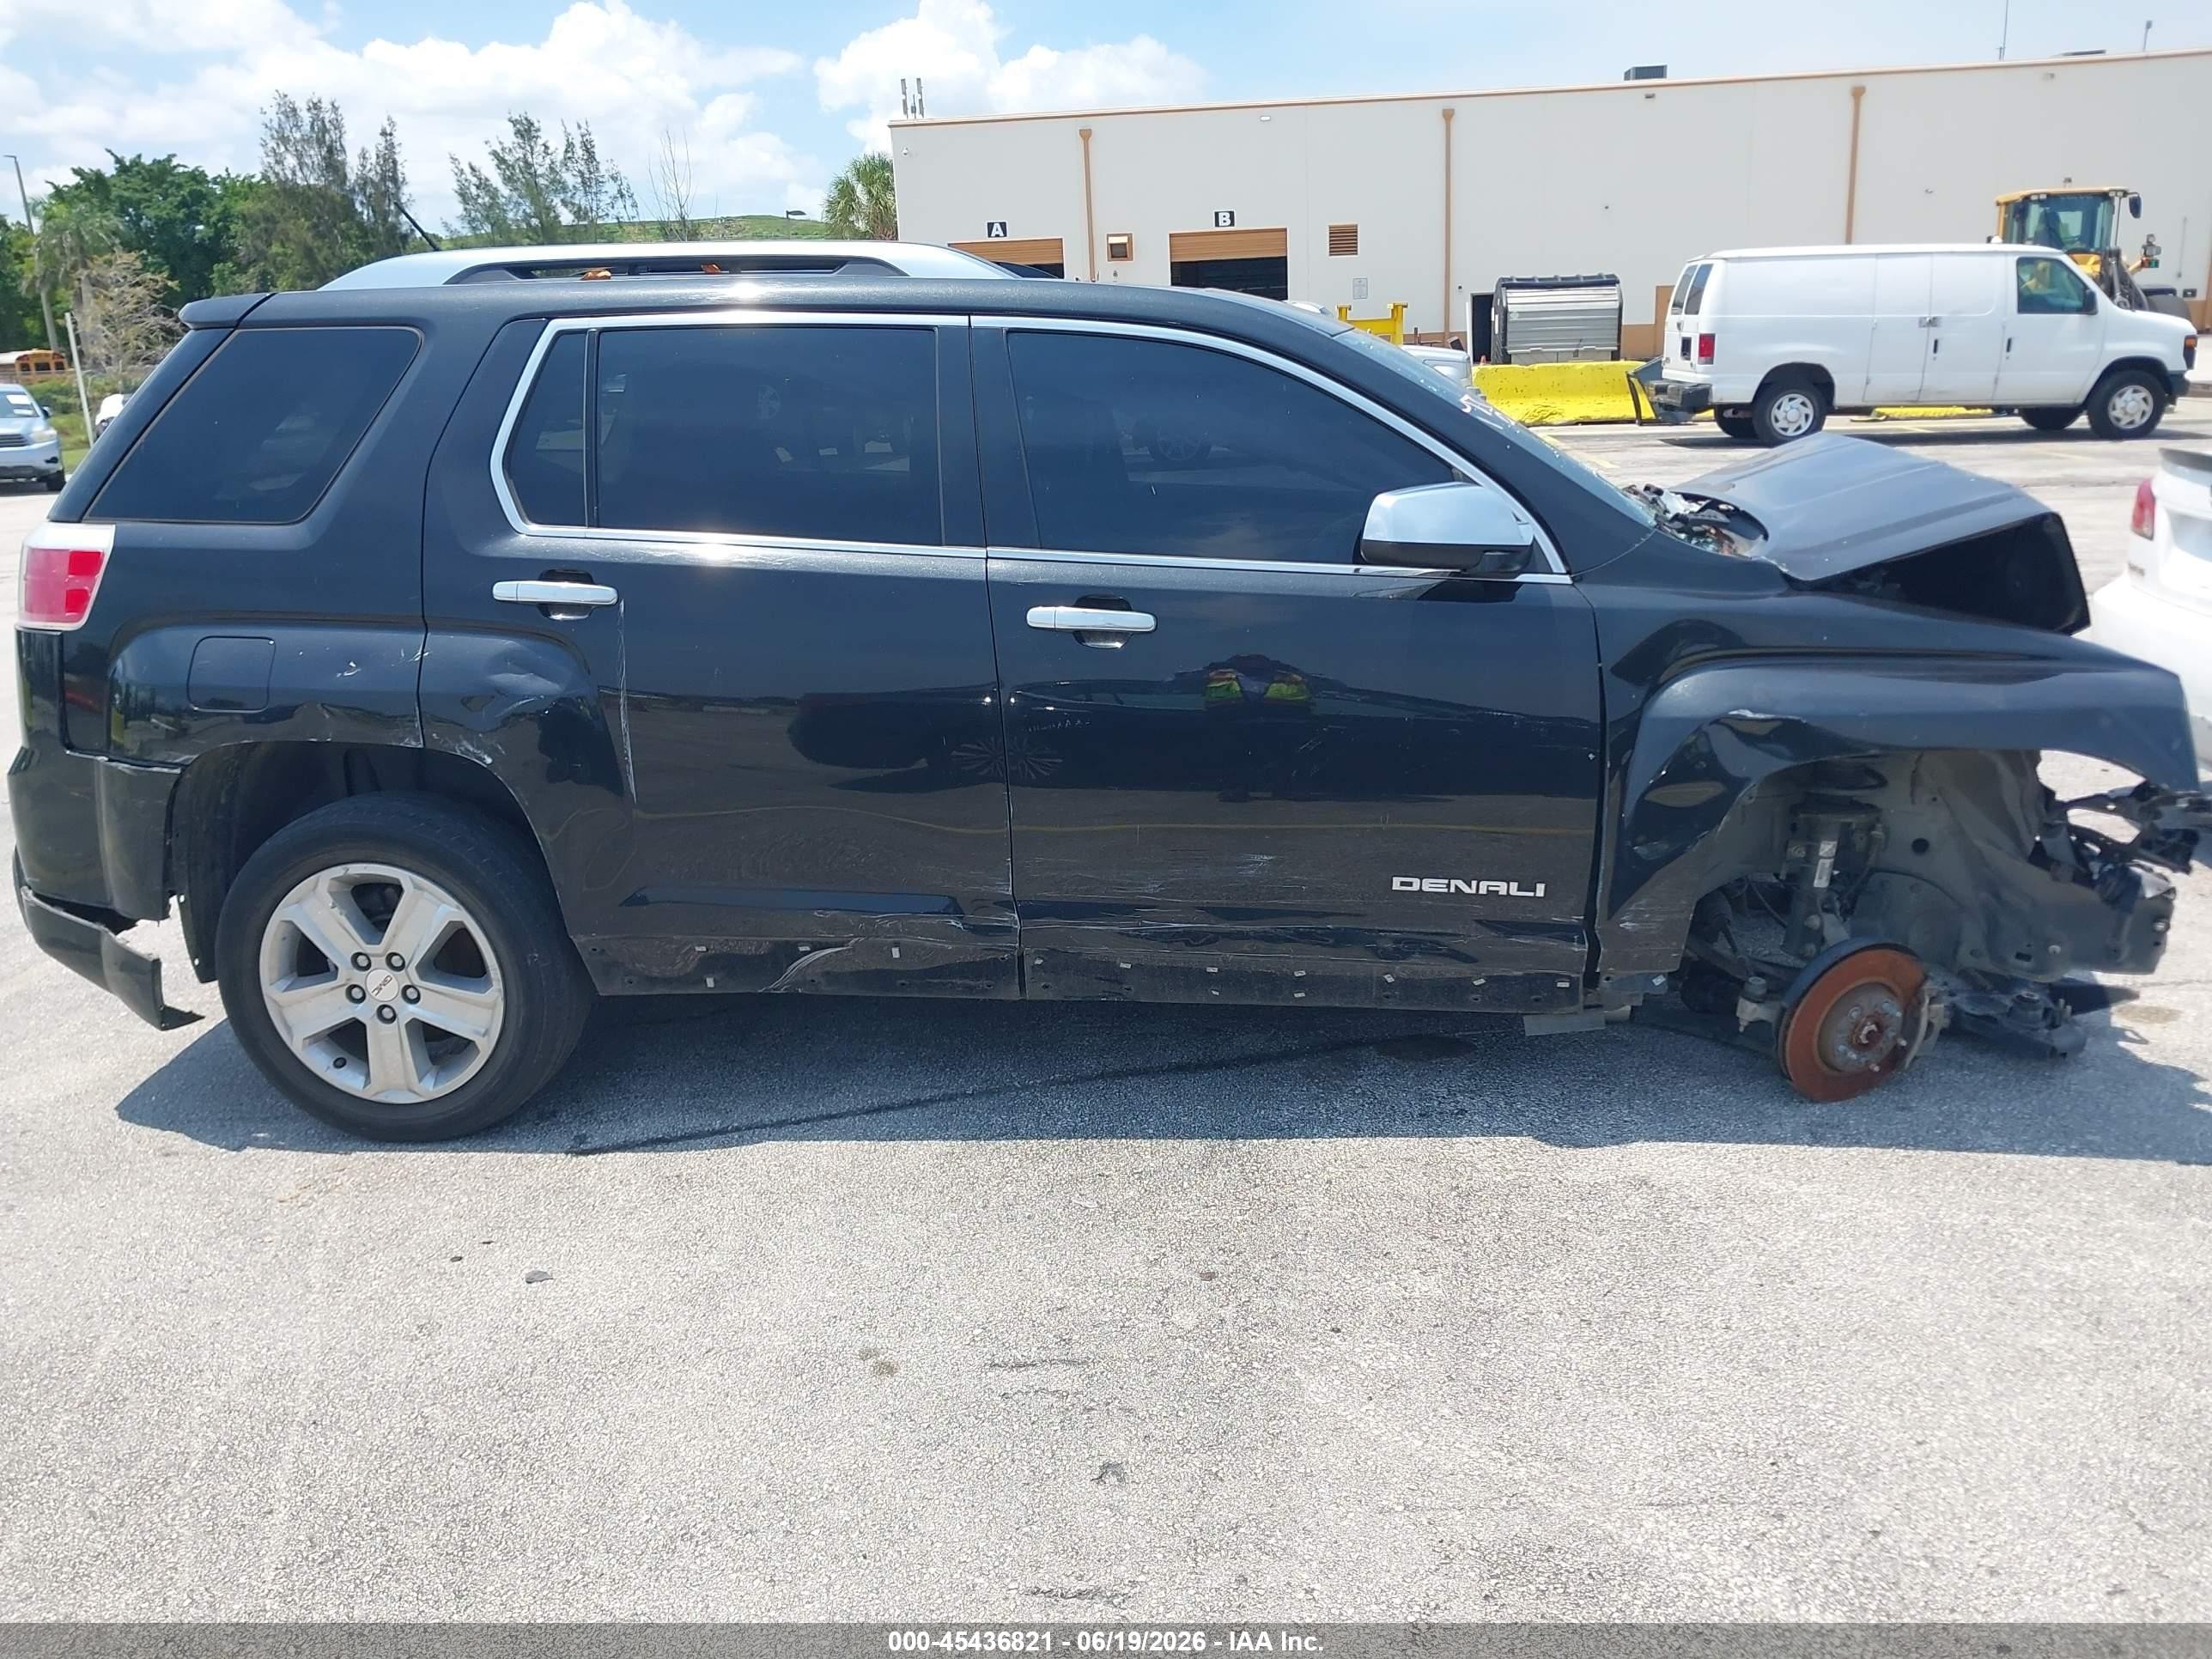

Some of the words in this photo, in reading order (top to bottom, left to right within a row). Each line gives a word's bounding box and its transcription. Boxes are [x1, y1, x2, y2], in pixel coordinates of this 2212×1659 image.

[1218, 212, 1231, 227] B
[990, 222, 1005, 237] A
[1391, 876, 1547, 898] DENALI
